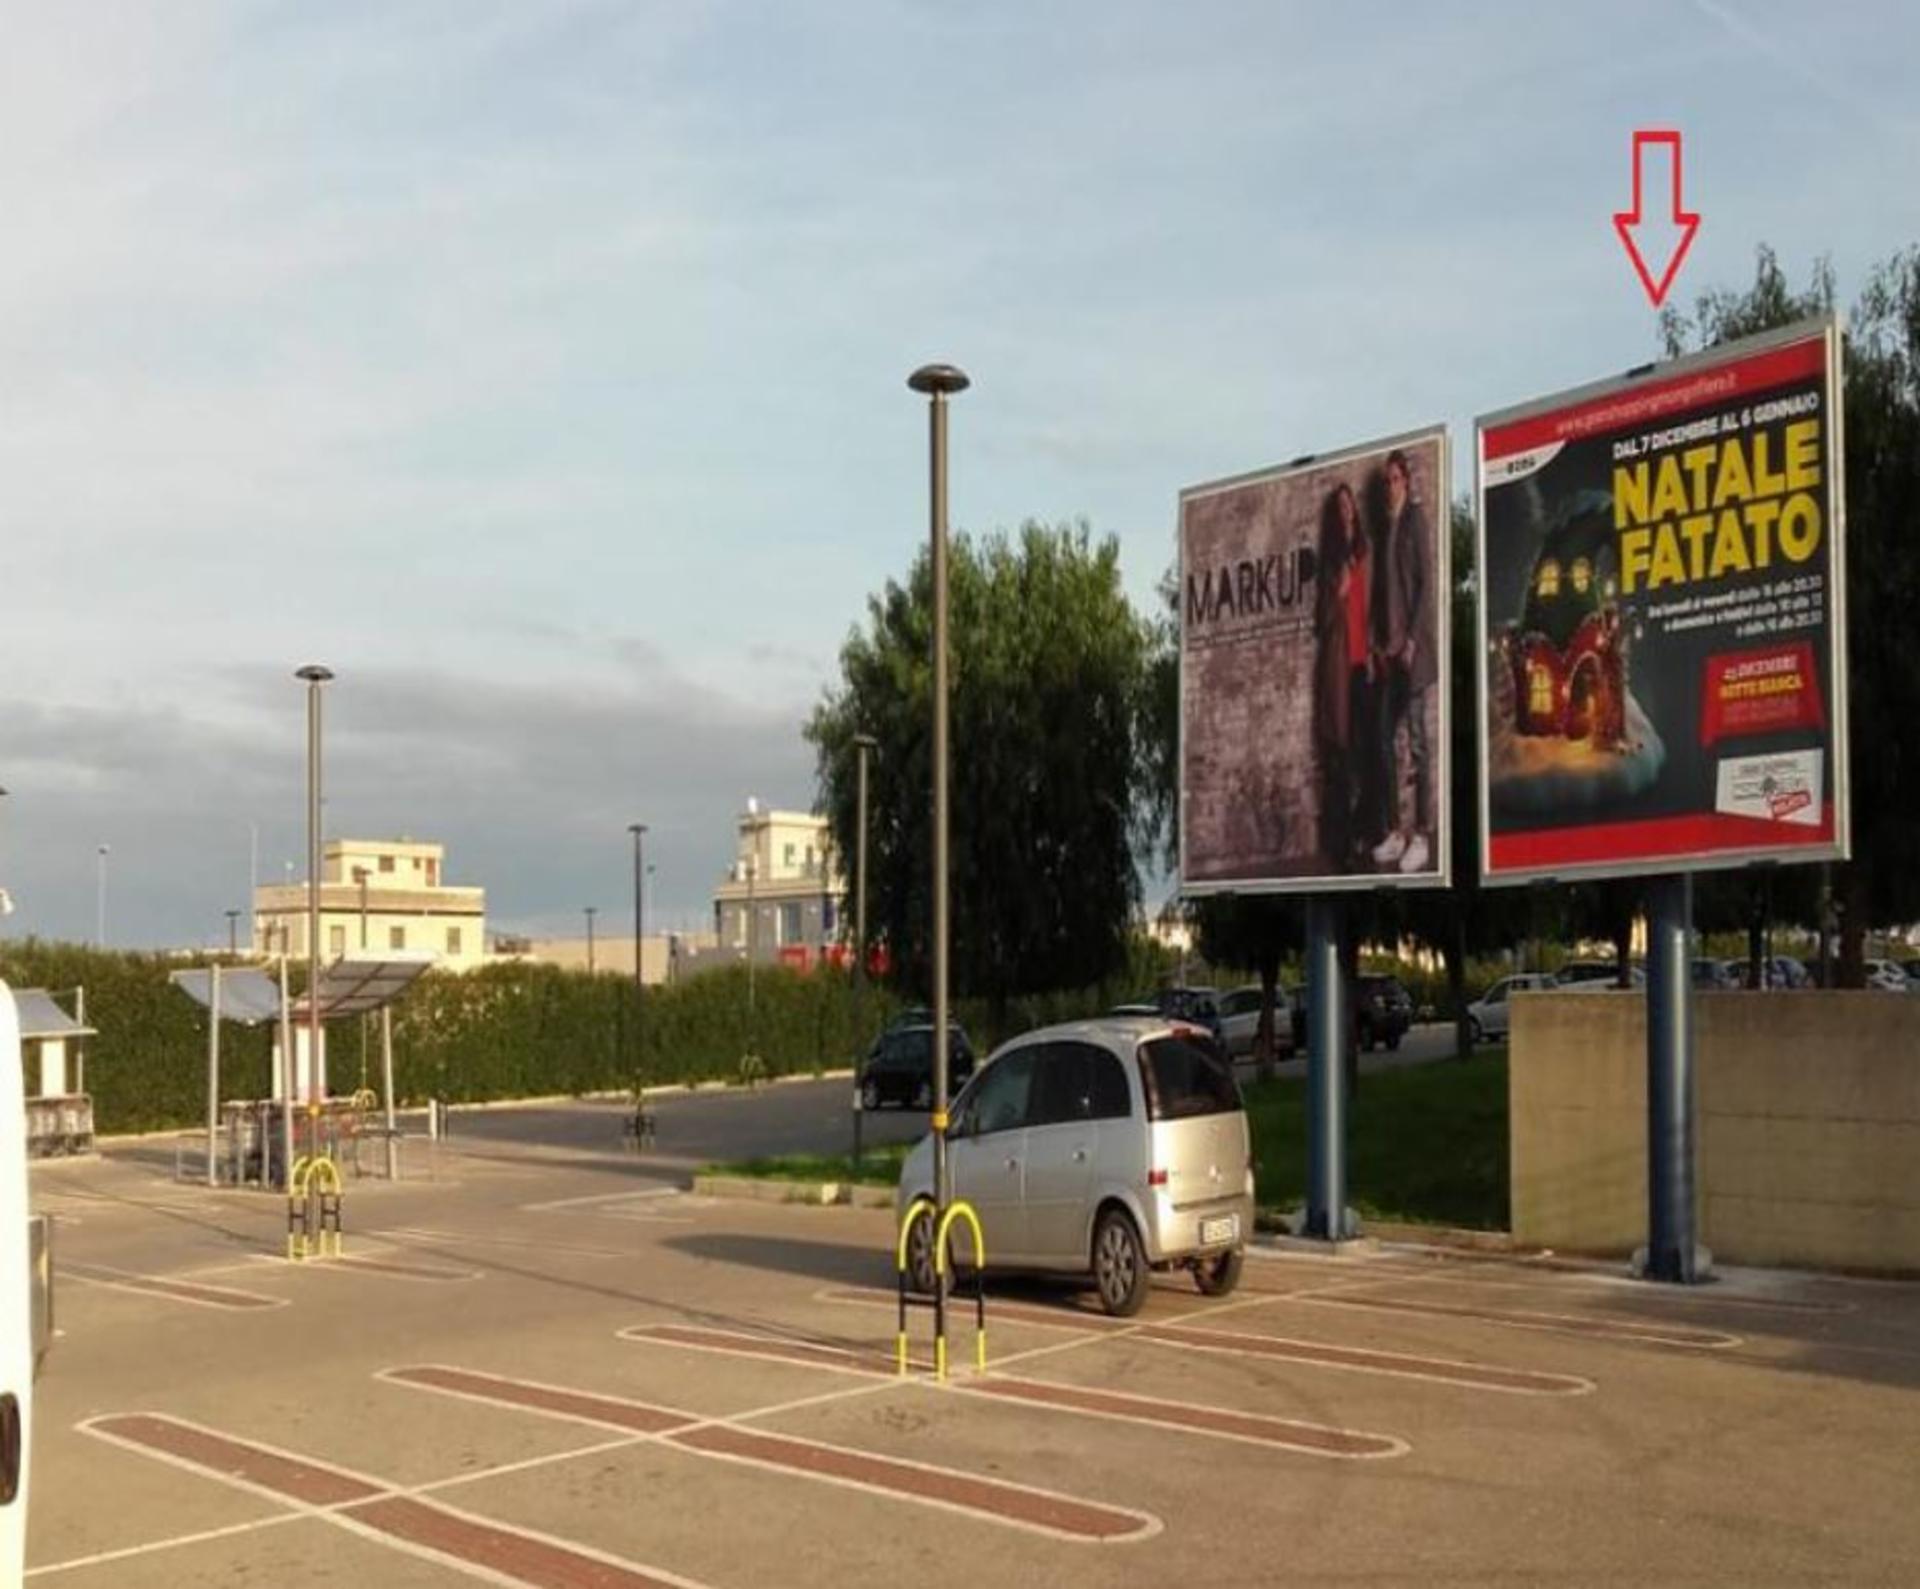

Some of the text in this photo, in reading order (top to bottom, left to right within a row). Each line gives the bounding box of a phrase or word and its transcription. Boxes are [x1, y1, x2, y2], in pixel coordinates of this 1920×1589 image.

[1613, 392, 1818, 459] DAL 7 DICEMBRE AL 6 GENNAIO
[1613, 419, 1821, 528] NATALE
[1187, 547, 1316, 627] MARKUP
[1620, 492, 1822, 595] FATATO
